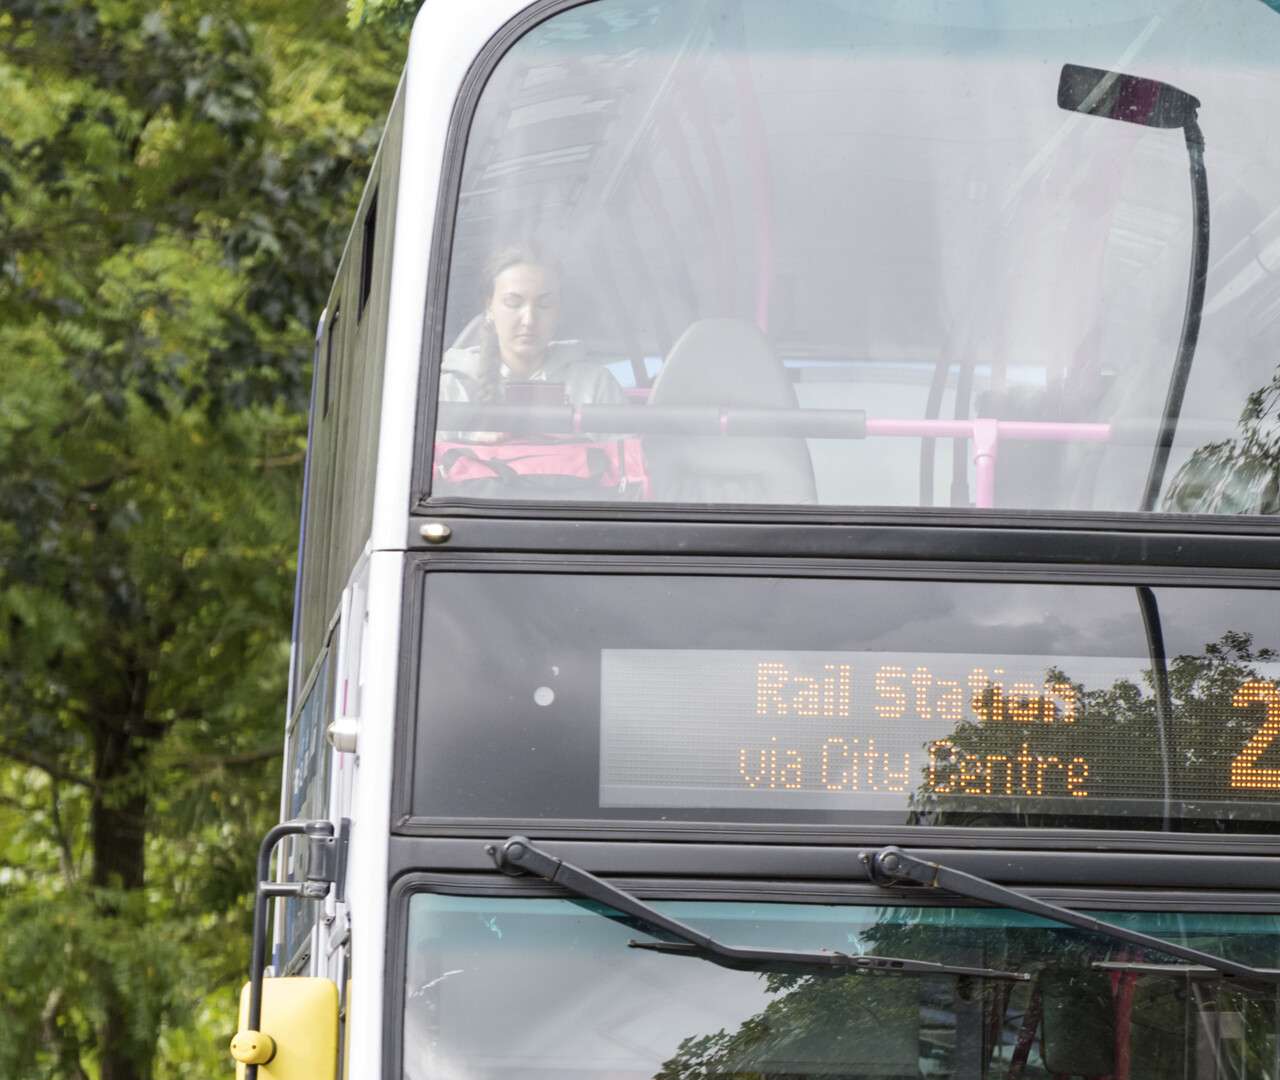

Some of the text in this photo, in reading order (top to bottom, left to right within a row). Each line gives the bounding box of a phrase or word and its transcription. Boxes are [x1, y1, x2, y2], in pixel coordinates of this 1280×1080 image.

[756, 662, 1075, 722] Rail Station
[740, 736, 1088, 796] via City Centre
